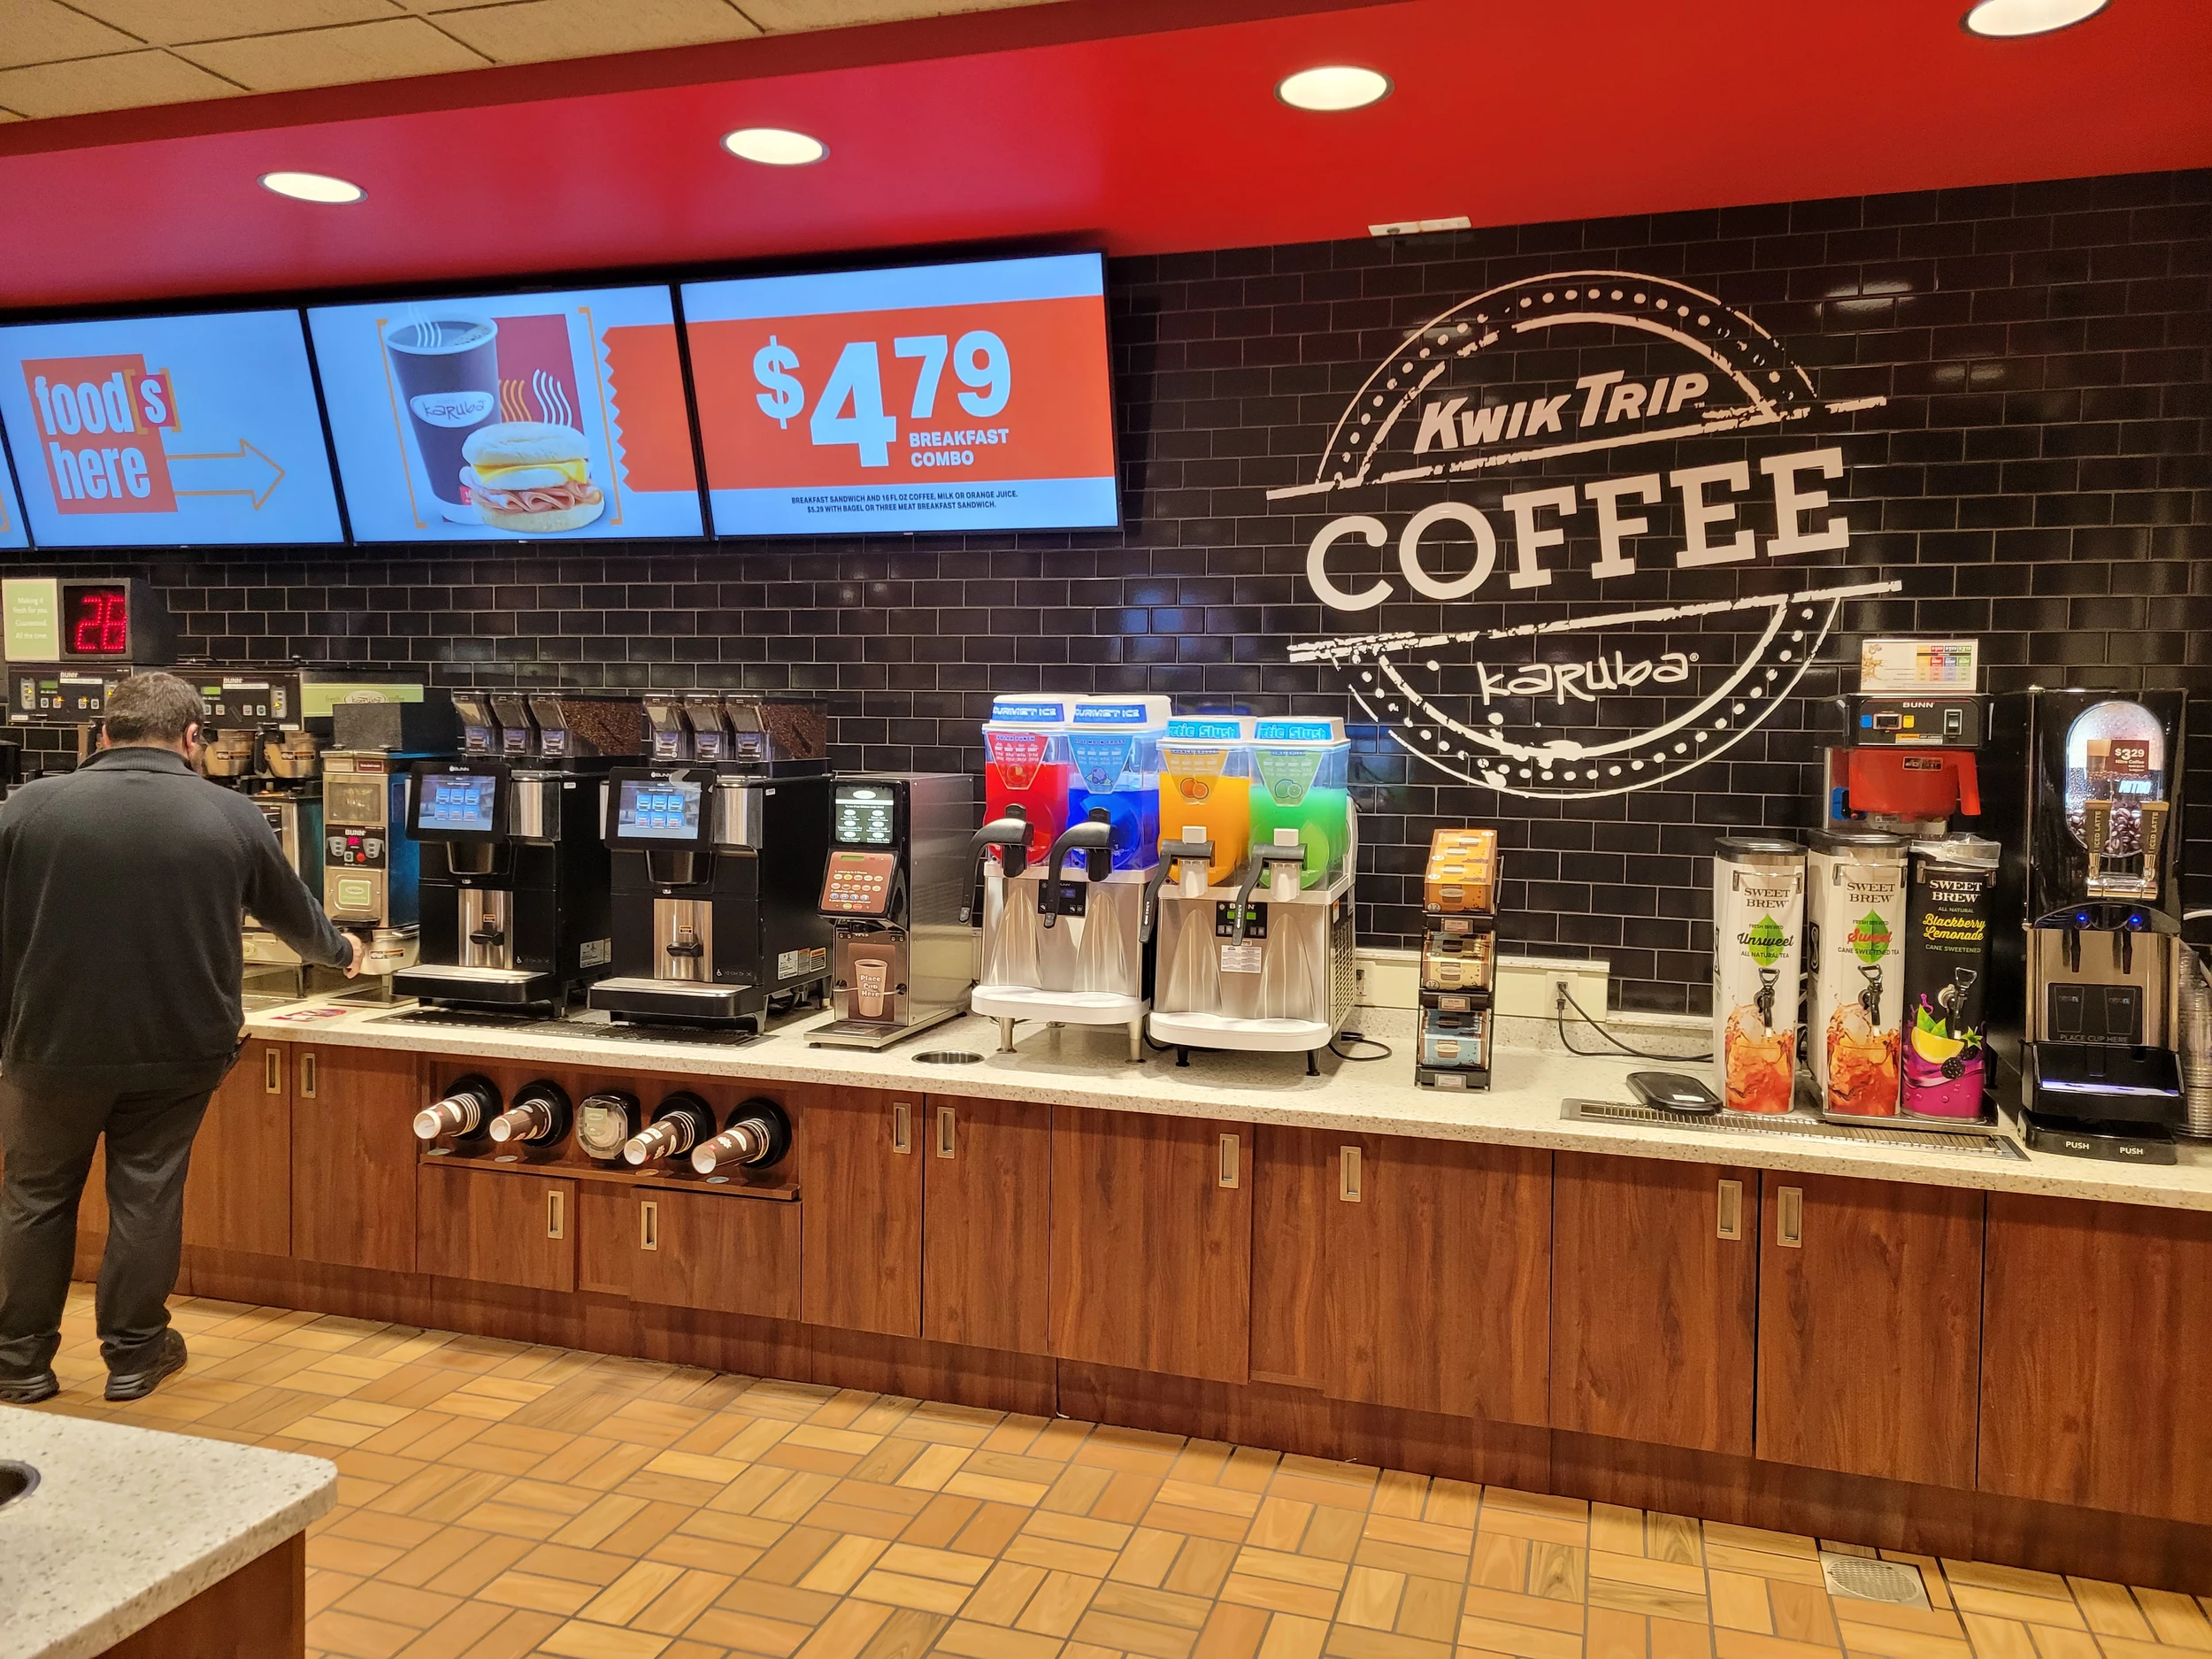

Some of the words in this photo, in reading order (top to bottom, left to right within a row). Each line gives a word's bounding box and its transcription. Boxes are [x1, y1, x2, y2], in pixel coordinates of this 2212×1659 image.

[1413, 394, 1572, 455] KWIK
[1576, 370, 1709, 427] TRIP
[909, 428, 1010, 448] BREAKFAST
[910, 449, 974, 468] COMBO
[49, 442, 151, 499] here
[1307, 447, 1850, 611] COFFEE
[1199, 726, 1236, 739] Slush
[1289, 726, 1326, 740] Slush
[1744, 887, 1791, 898] SWEET
[1847, 882, 1895, 893] SWEET
[1929, 879, 1983, 892] SWEET
[1746, 899, 1788, 908] BREW
[1849, 894, 1893, 903] BREW
[1932, 891, 1978, 903] BREW
[1922, 913, 1986, 932] Blackberry
[1737, 932, 1794, 947] Unsweet
[1847, 928, 1893, 944] Sweet
[1923, 926, 1984, 941] Lemonade
[2060, 1033, 2085, 1042] PLACE
[2065, 1141, 2090, 1150] PUSH
